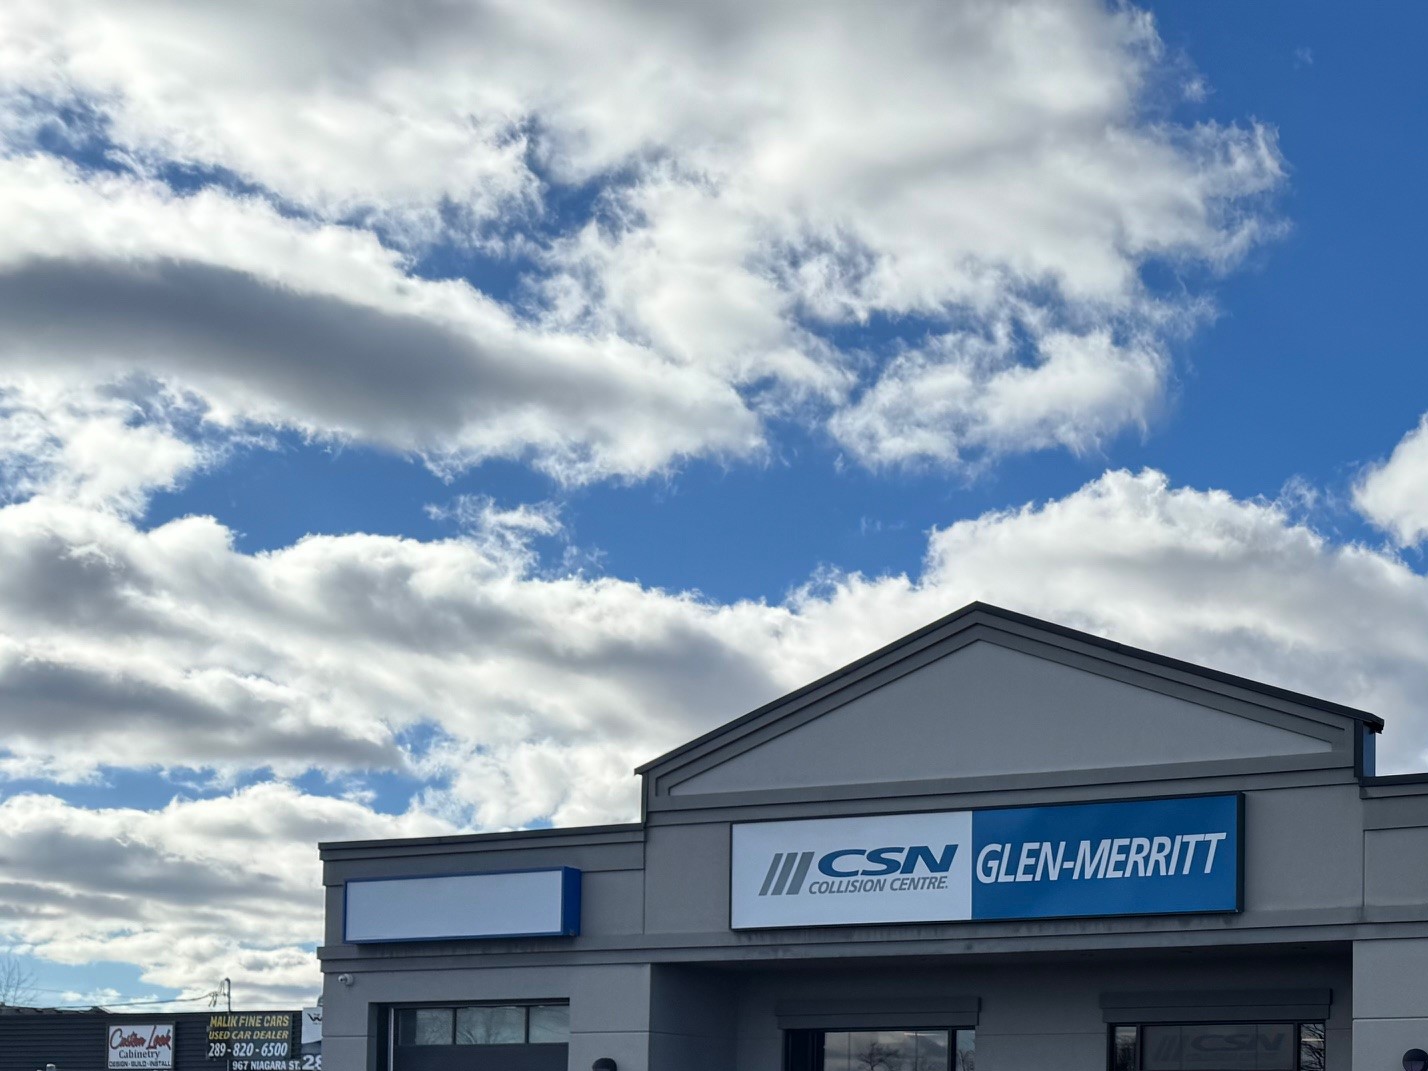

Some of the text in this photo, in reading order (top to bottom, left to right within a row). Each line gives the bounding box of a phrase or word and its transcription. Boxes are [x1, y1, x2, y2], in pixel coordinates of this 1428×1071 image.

[817, 844, 959, 878] CSN
[976, 832, 1227, 884] GLEN-MERRITT
[808, 879, 886, 895] COLLISION
[210, 1015, 289, 1027] MALIK FINE CARS
[208, 1031, 289, 1040] USED CAR DEALER
[119, 1049, 161, 1061] Cabinetry
[232, 1061, 249, 1070] 967
[250, 1061, 287, 1070] NIAGARA
